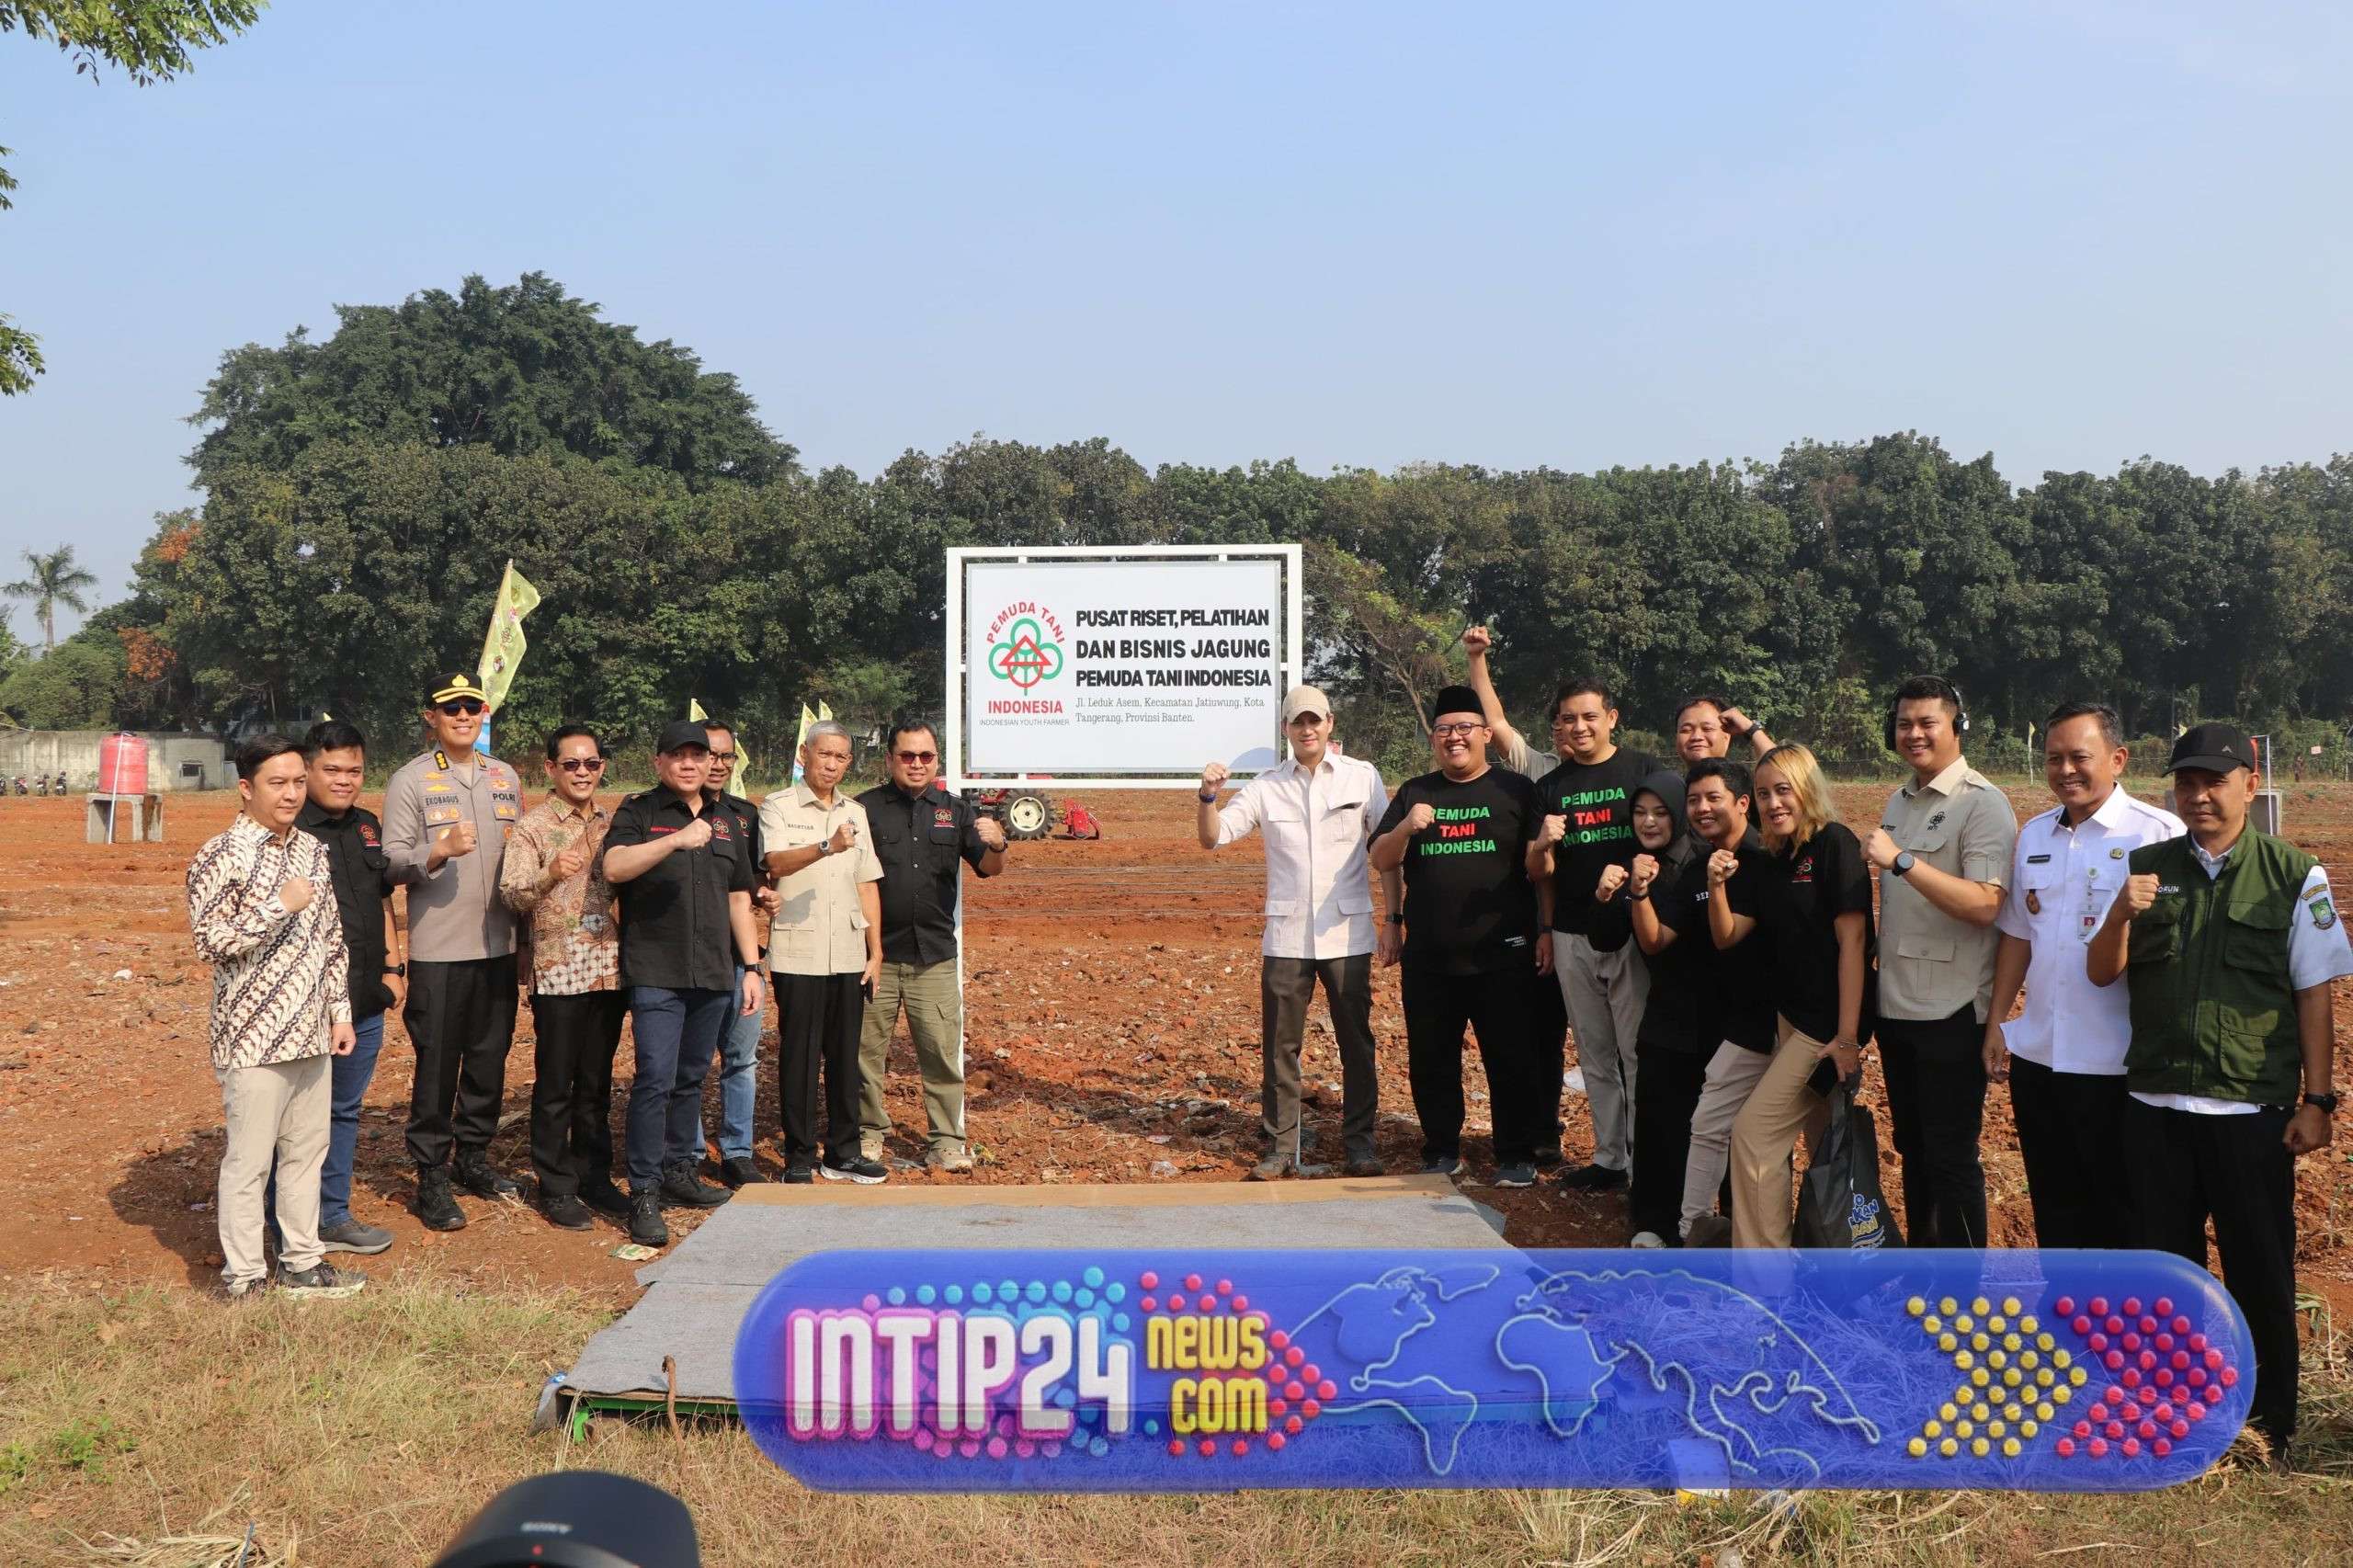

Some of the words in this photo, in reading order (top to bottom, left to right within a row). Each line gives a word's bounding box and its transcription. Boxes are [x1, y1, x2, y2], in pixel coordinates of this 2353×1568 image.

[986, 602, 1036, 644] PEMUDA
[1040, 608, 1065, 643] TANI
[1076, 610, 1128, 627] PUSAT
[1130, 610, 1178, 629] RISET,
[1180, 609, 1269, 626] PELATIHAN
[1076, 640, 1116, 659] DAN
[1120, 640, 1186, 658] BISNIS
[1190, 639, 1270, 658] JAGUNG
[1076, 670, 1143, 687] PEMUDA
[1145, 670, 1183, 687] TANI
[1184, 669, 1272, 687] INDONESIA
[988, 700, 1063, 714] INDONESIA
[1087, 698, 1113, 707] Leduk
[1144, 697, 1193, 707] Kecamatan
[1244, 697, 1265, 707] Kota
[1043, 718, 1070, 726] FARMER
[1125, 712, 1160, 722] Provinsi
[1162, 712, 1195, 722] Banten.
[1562, 788, 1625, 808] PEMUDA
[1574, 809, 1610, 825] TANI
[1439, 823, 1475, 837] TANI
[1420, 839, 1496, 856] INDONESIA
